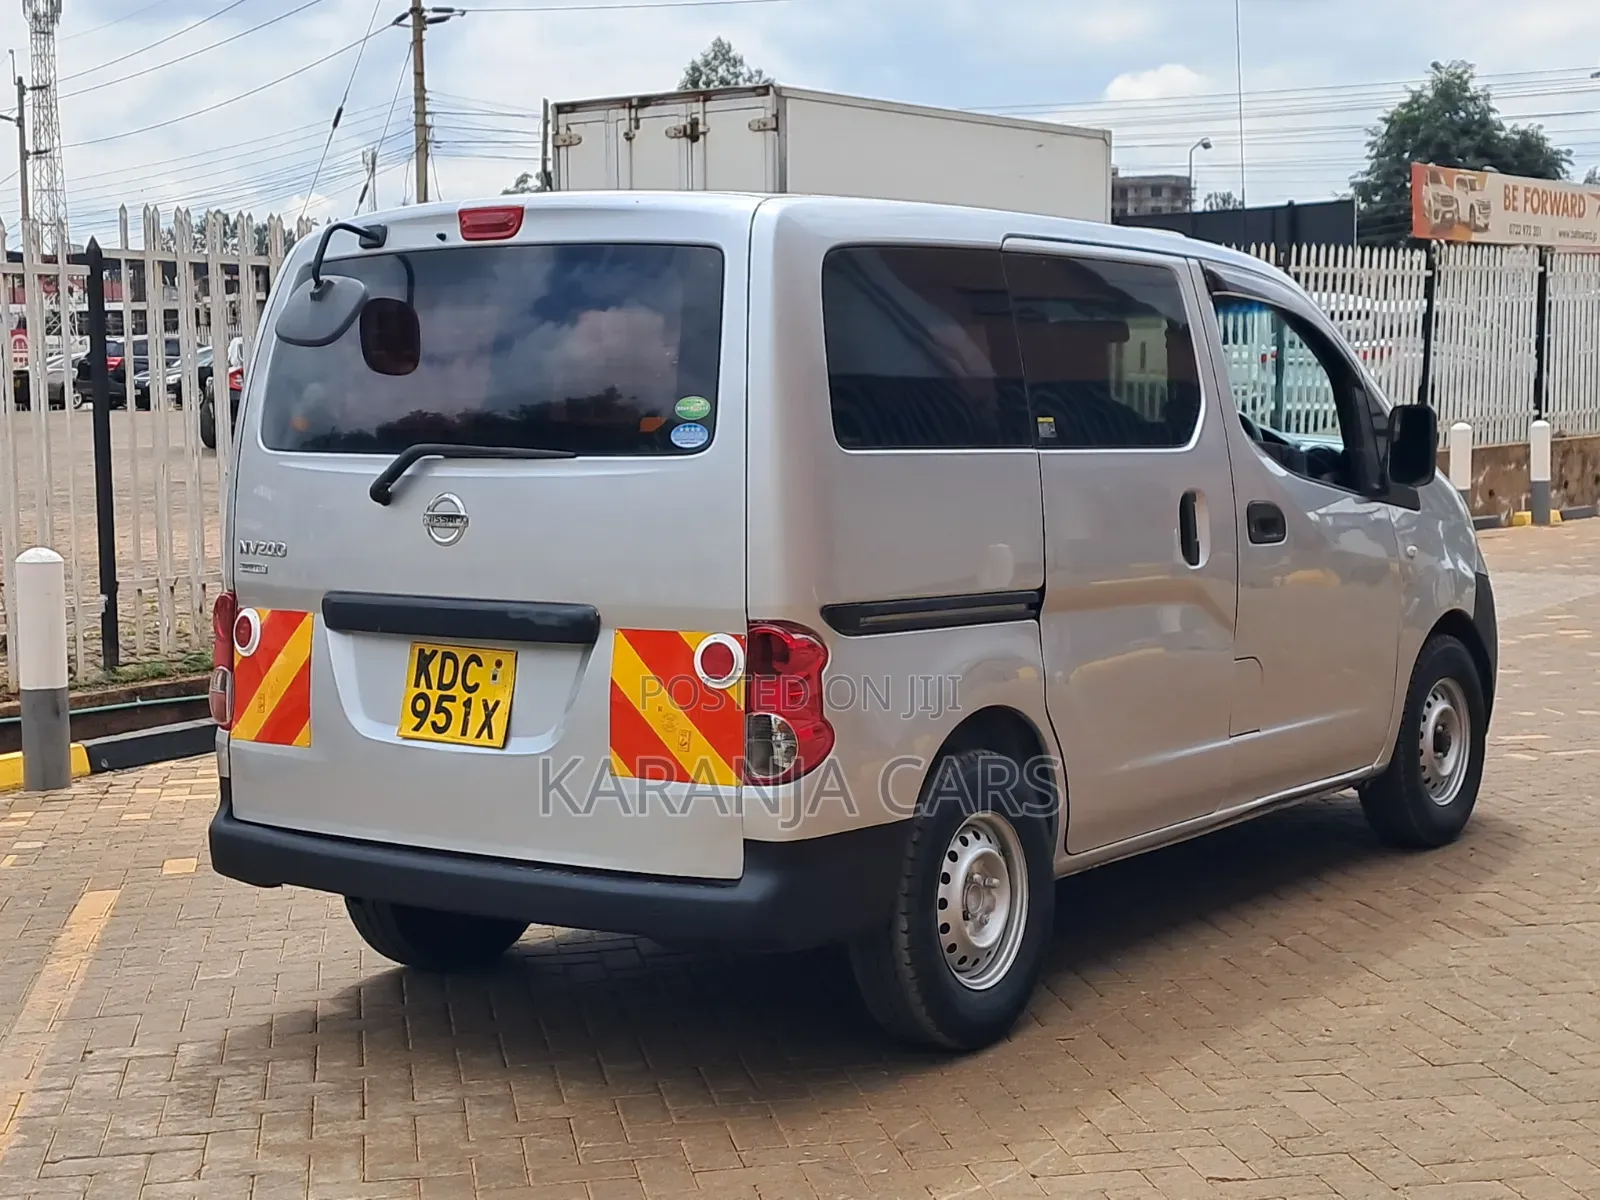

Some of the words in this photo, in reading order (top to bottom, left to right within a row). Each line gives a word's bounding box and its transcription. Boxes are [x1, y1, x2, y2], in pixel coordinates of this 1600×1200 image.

[1503, 183, 1519, 212] BE
[1523, 186, 1587, 218] FORWARD
[413, 648, 483, 694] KDC
[410, 692, 501, 740] 951X
